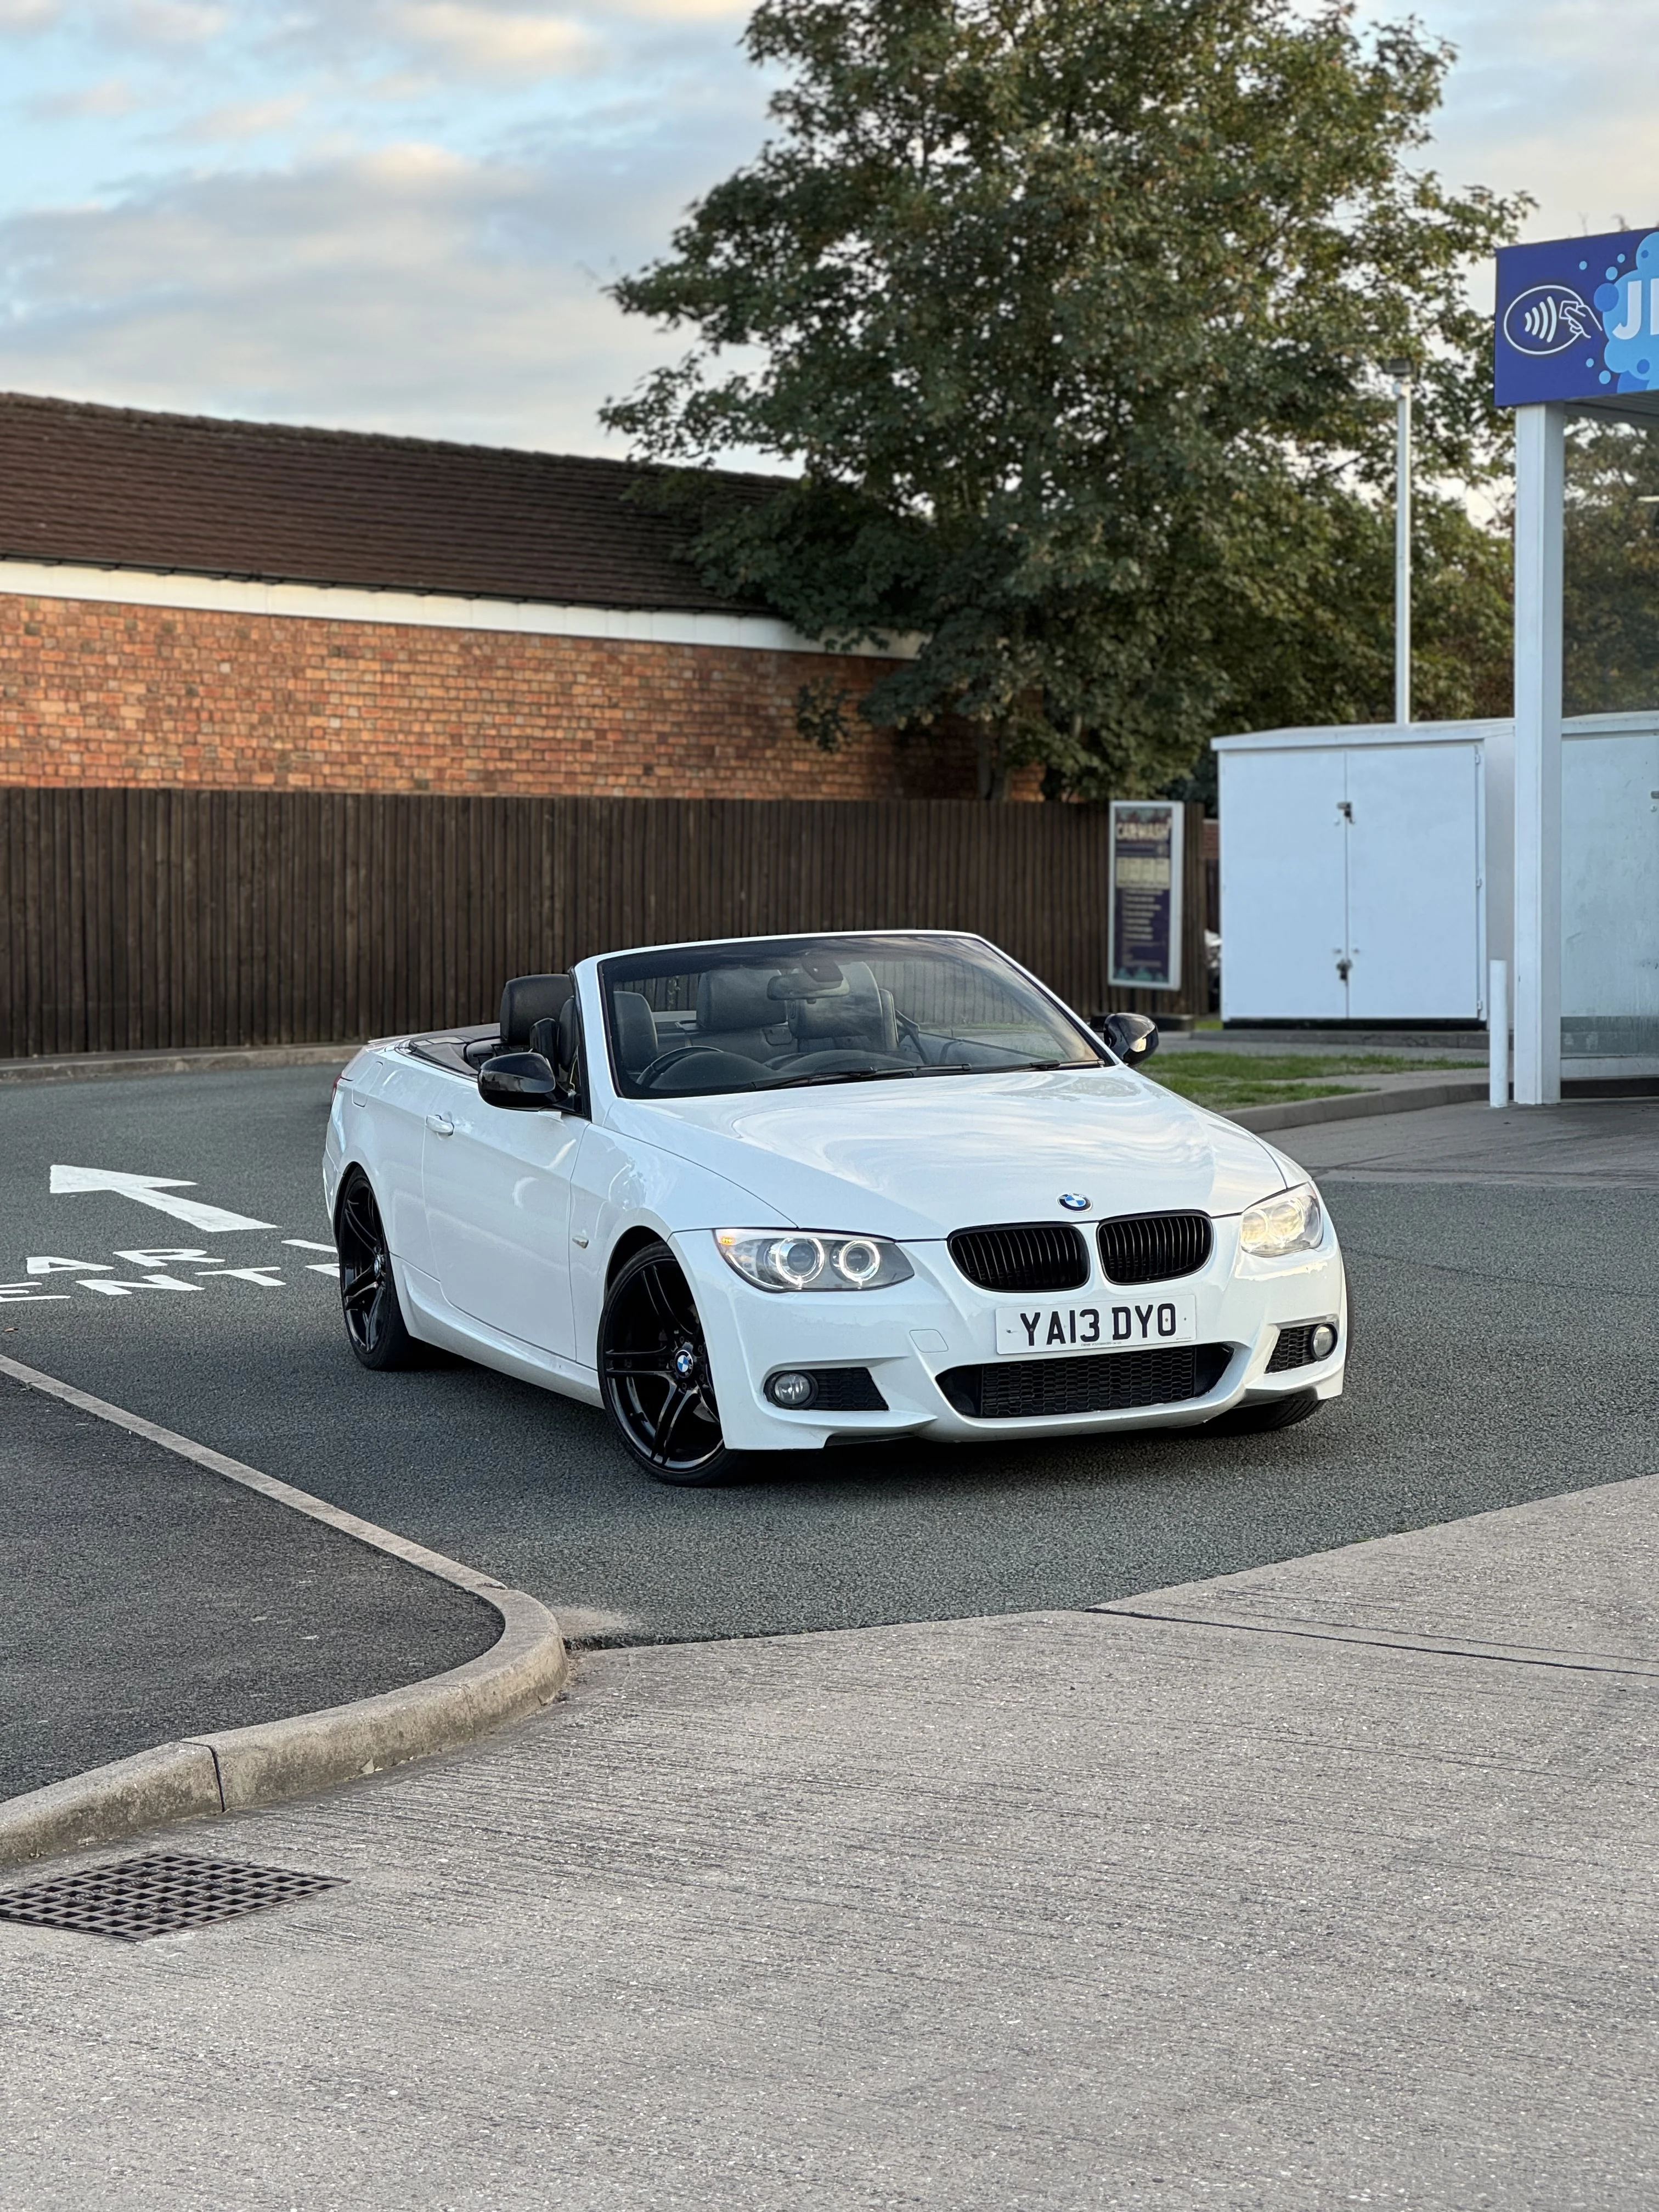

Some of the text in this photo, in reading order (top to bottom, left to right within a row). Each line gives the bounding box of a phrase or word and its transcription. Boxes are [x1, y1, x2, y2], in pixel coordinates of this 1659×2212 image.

[0, 1263, 340, 1302] ENT
[1020, 1303, 1176, 1346] YA13 DYO
